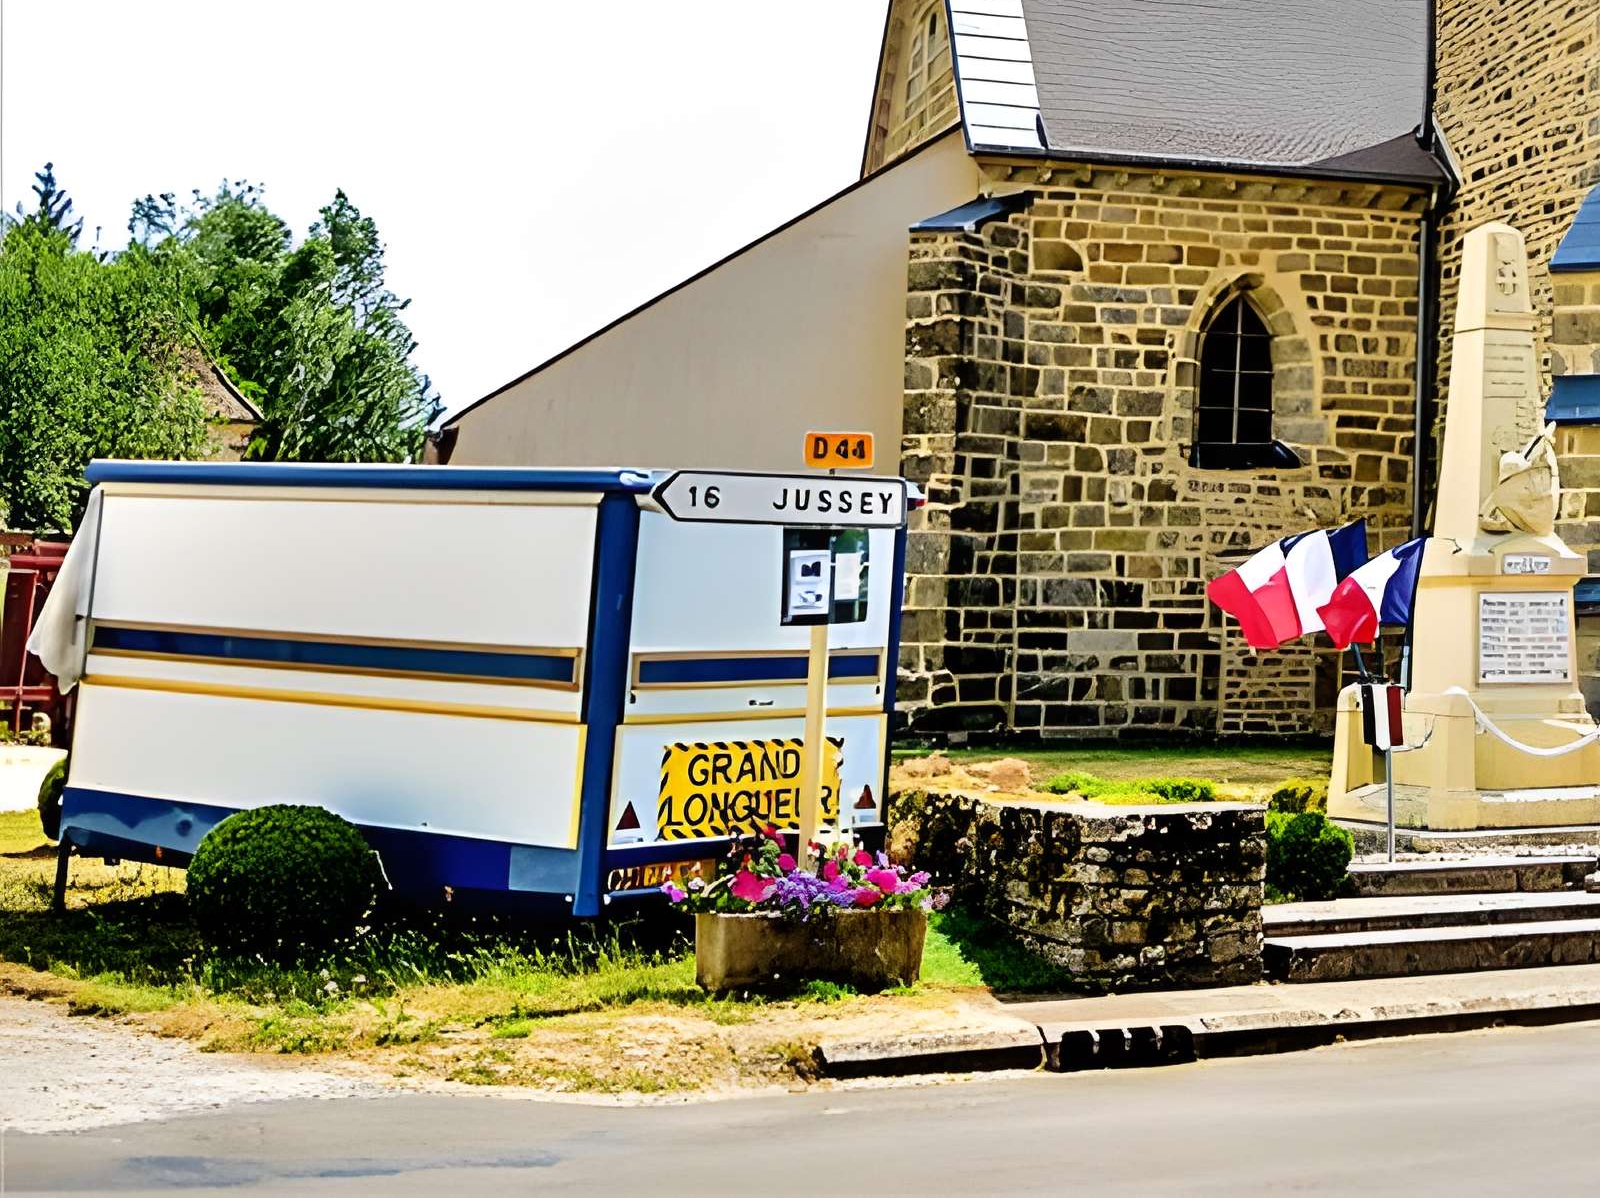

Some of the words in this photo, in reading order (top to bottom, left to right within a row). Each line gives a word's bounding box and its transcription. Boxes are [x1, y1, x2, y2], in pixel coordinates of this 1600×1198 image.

[812, 436, 829, 460] D
[688, 485, 721, 510] 16
[772, 488, 893, 515] JUSSEY
[687, 748, 801, 787] GRAND
